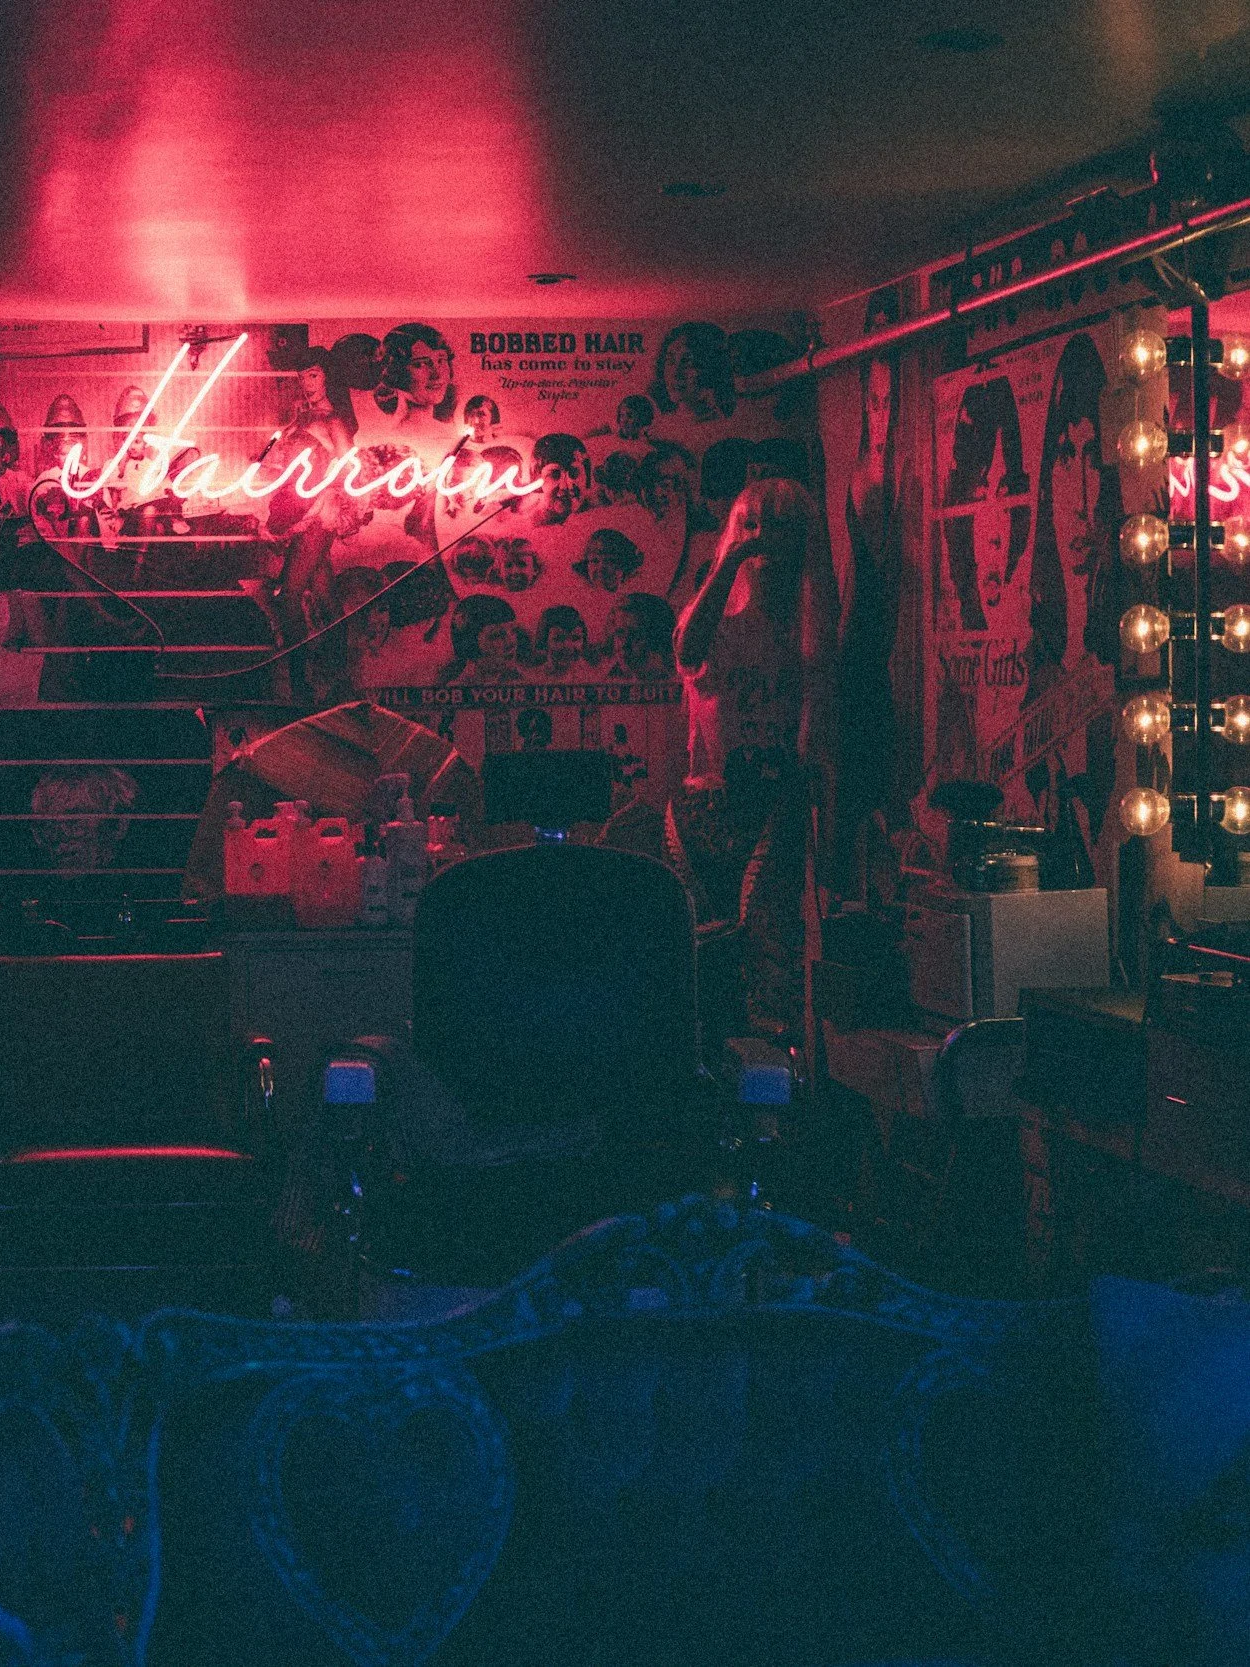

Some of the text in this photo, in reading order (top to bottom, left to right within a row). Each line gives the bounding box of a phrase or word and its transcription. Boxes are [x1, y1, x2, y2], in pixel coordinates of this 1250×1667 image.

[470, 332, 645, 355] BOBBED HAIR
[481, 355, 636, 376] has come to stay
[59, 332, 546, 500] Hairroin
[983, 639, 1028, 687] Girls
[421, 688, 464, 705] BOB
[469, 687, 527, 704] YOUR
[533, 686, 587, 704] HAIR
[594, 685, 621, 702] TO
[628, 684, 678, 702] SUIT
